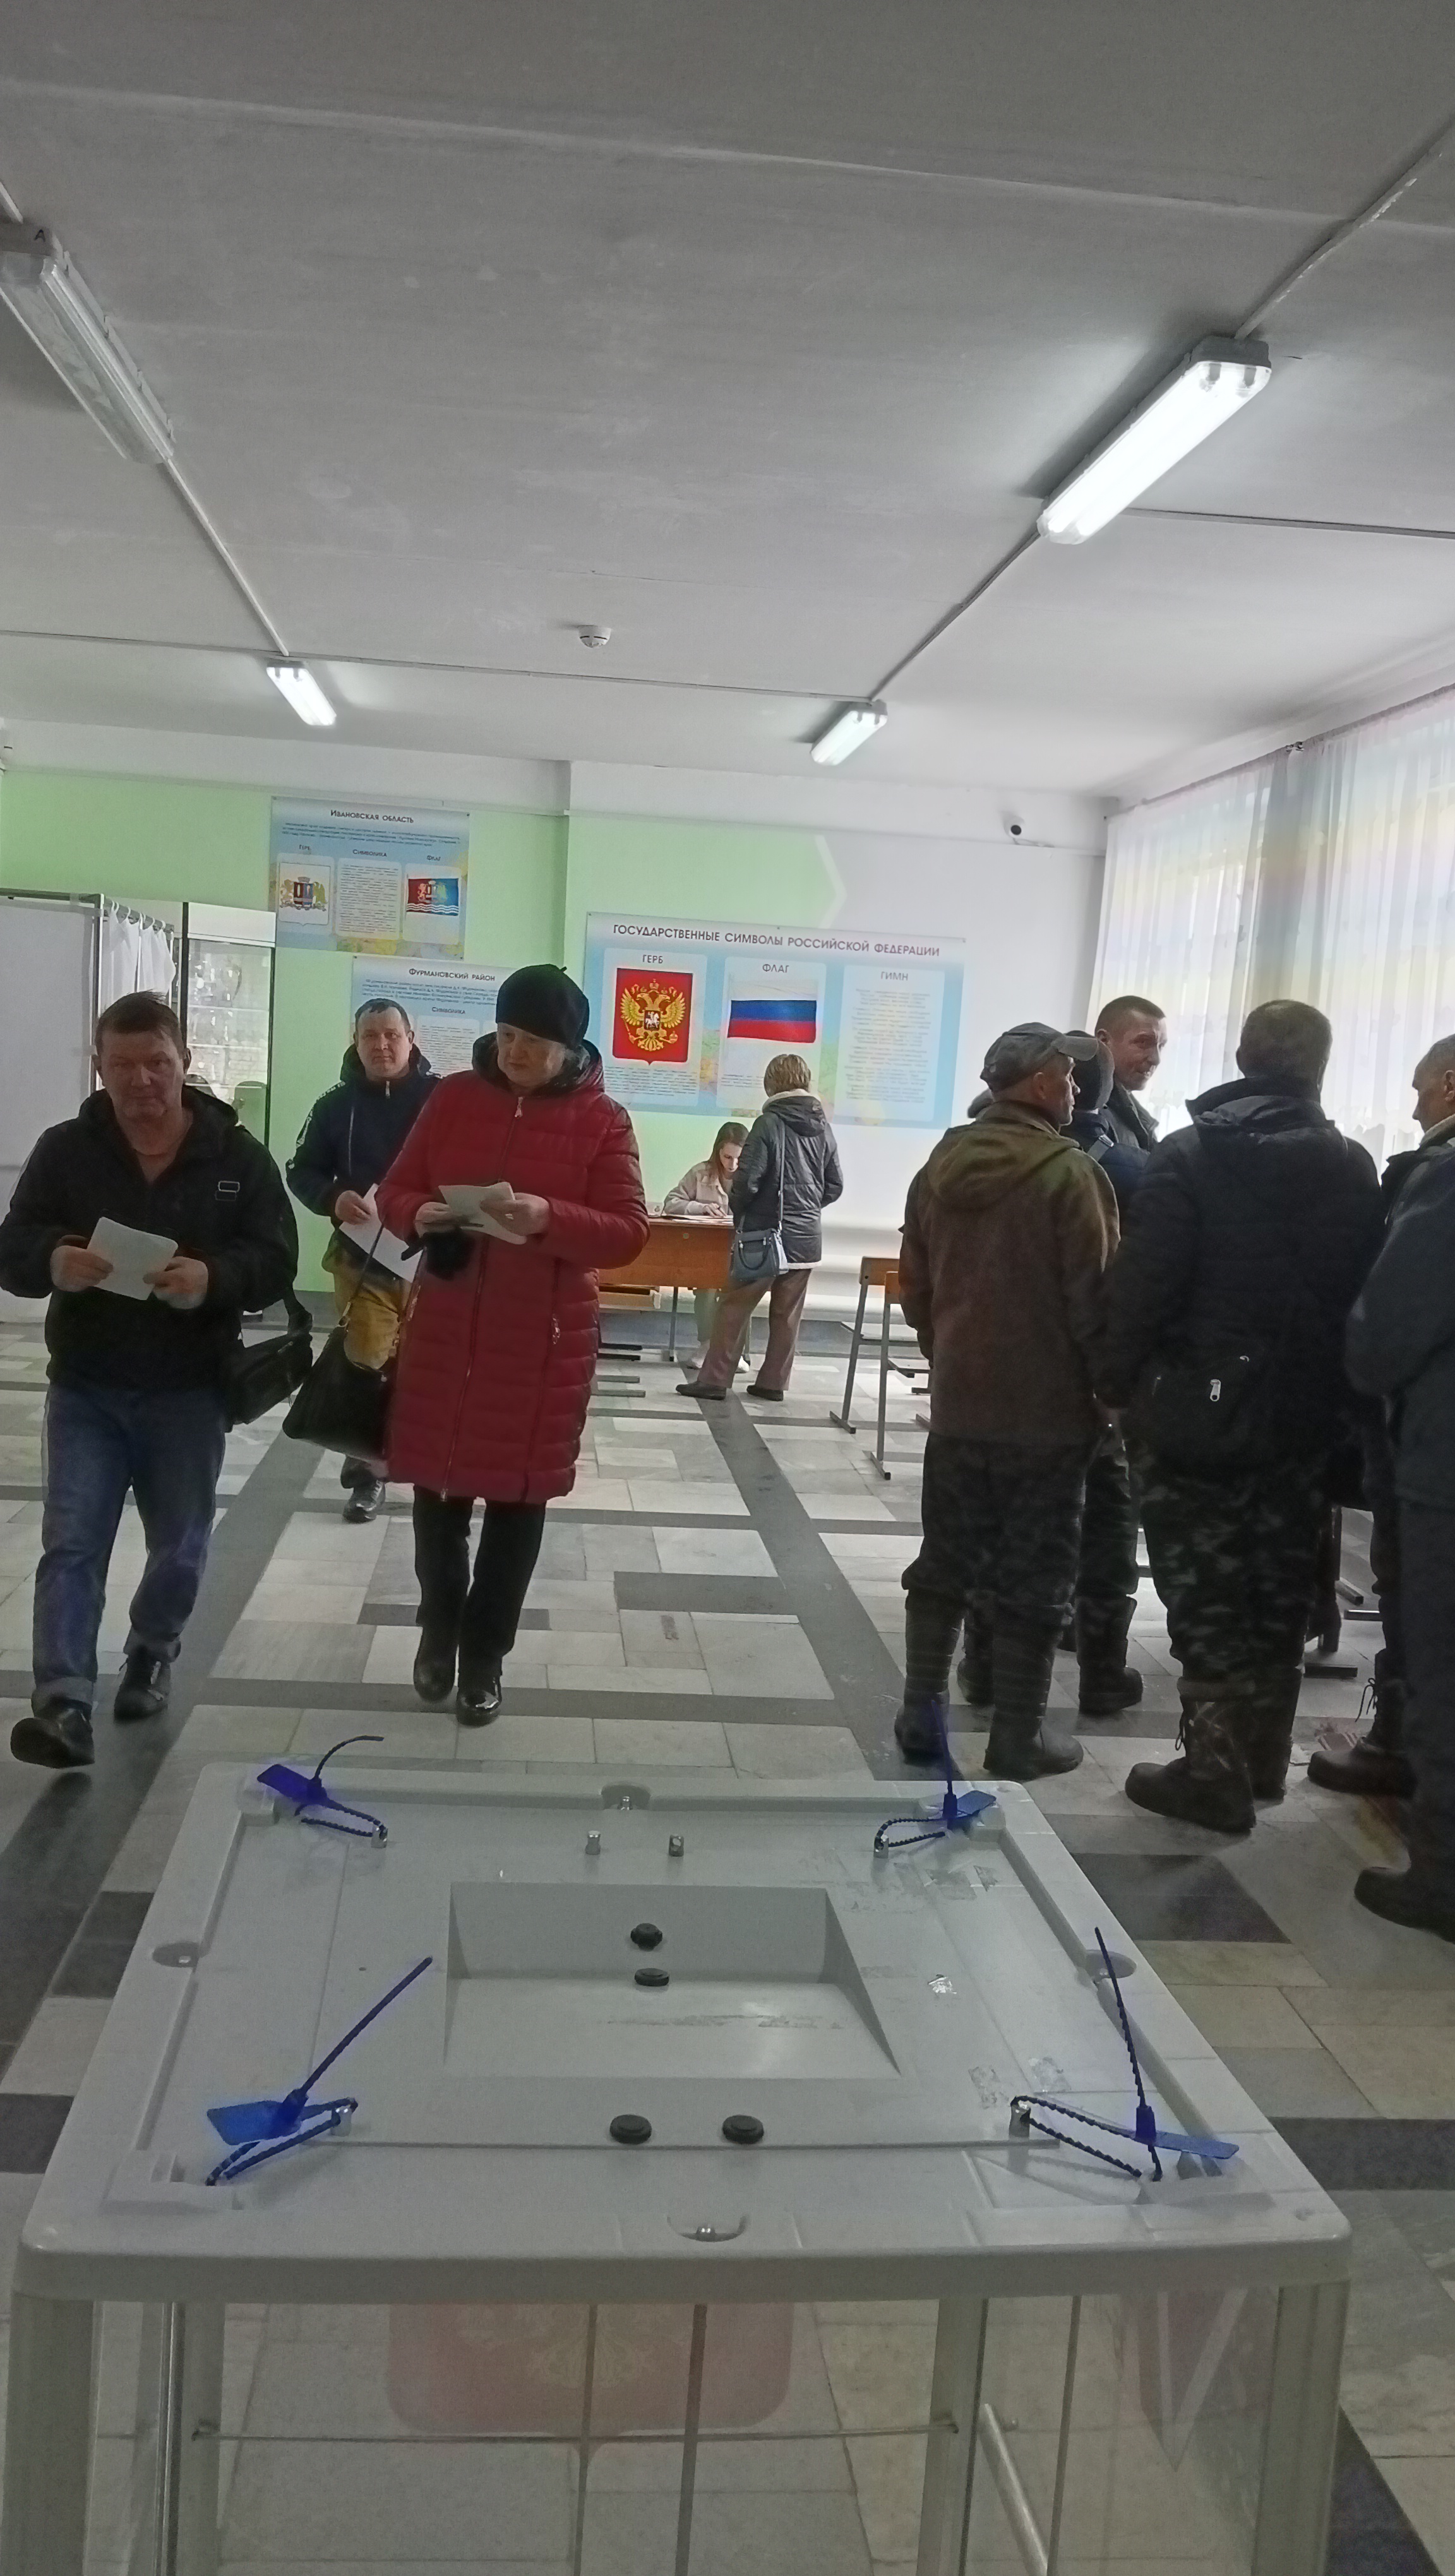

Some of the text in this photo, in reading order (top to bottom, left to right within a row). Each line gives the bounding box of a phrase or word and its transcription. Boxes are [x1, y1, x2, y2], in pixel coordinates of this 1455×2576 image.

[330, 809, 414, 823] ИВАНОВСКАЯ ОБЛАСТЬ
[613, 924, 940, 957] ГОСУДАРСТВЕННЫЕ СИМВОЛЫ РОССИЙСКОЙ ФЕДЕРАЦИИ
[642, 954, 664, 965] ГЕРБ
[762, 963, 790, 974] ФЛАГ
[409, 968, 496, 982] ФУРМАНОВСКИЙ РАЙОН
[880, 971, 909, 982] ГИМН
